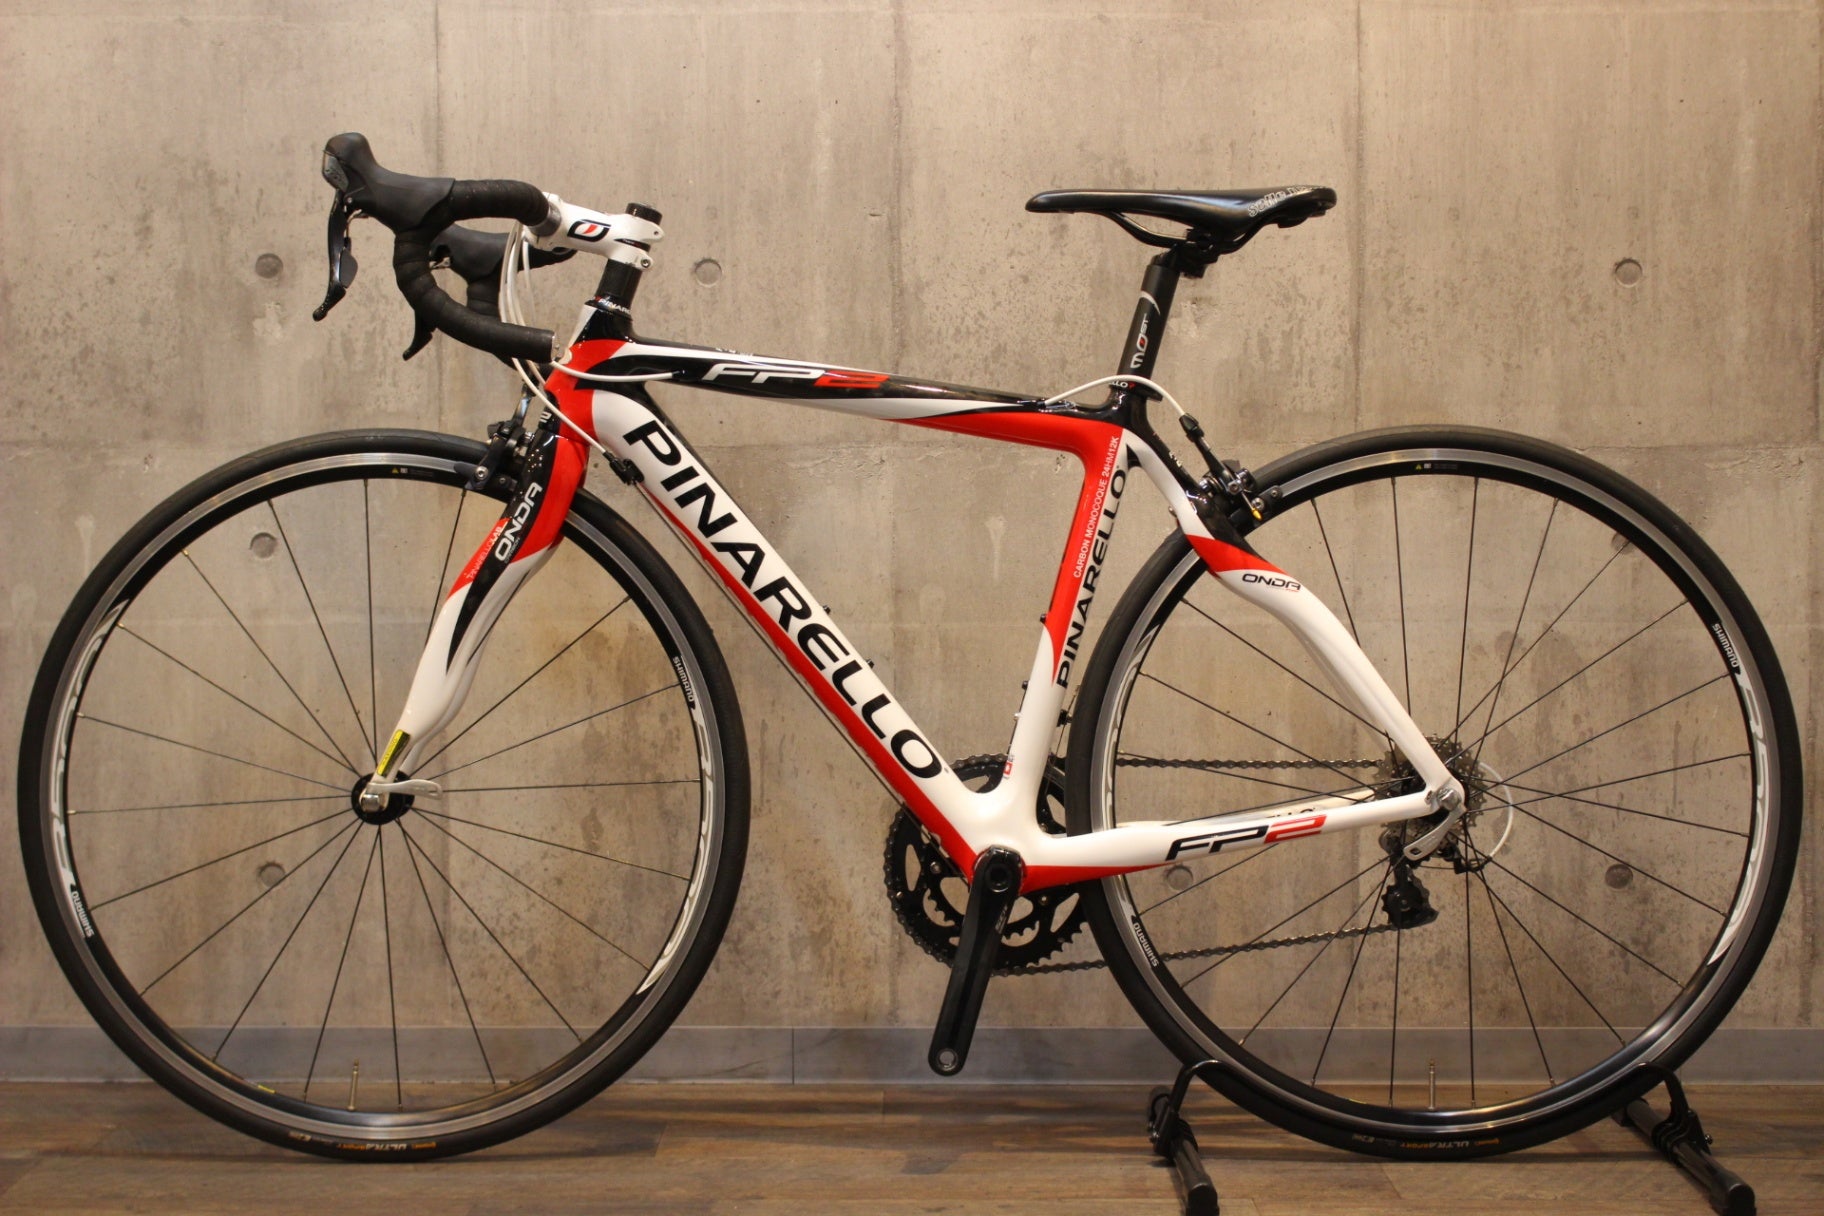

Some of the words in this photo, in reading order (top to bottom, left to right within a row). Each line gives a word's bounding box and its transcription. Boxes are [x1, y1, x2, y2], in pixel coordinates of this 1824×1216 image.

[702, 363, 890, 389] FP2
[494, 482, 544, 562] ONDA
[1073, 540, 1091, 578] CARBON
[1084, 478, 1108, 538] MONOCOQUE
[1101, 436, 1120, 478] 24HM12K
[622, 418, 943, 780] PINARELLO
[1056, 468, 1127, 689] PINARELLO
[1241, 573, 1302, 592] ONDA
[1712, 622, 1740, 669] SHIMANO
[672, 655, 694, 703] SHIMANO
[1165, 814, 1328, 862] FP2
[70, 890, 96, 939] SHIMANO
[1133, 922, 1160, 967] SHIMANO
